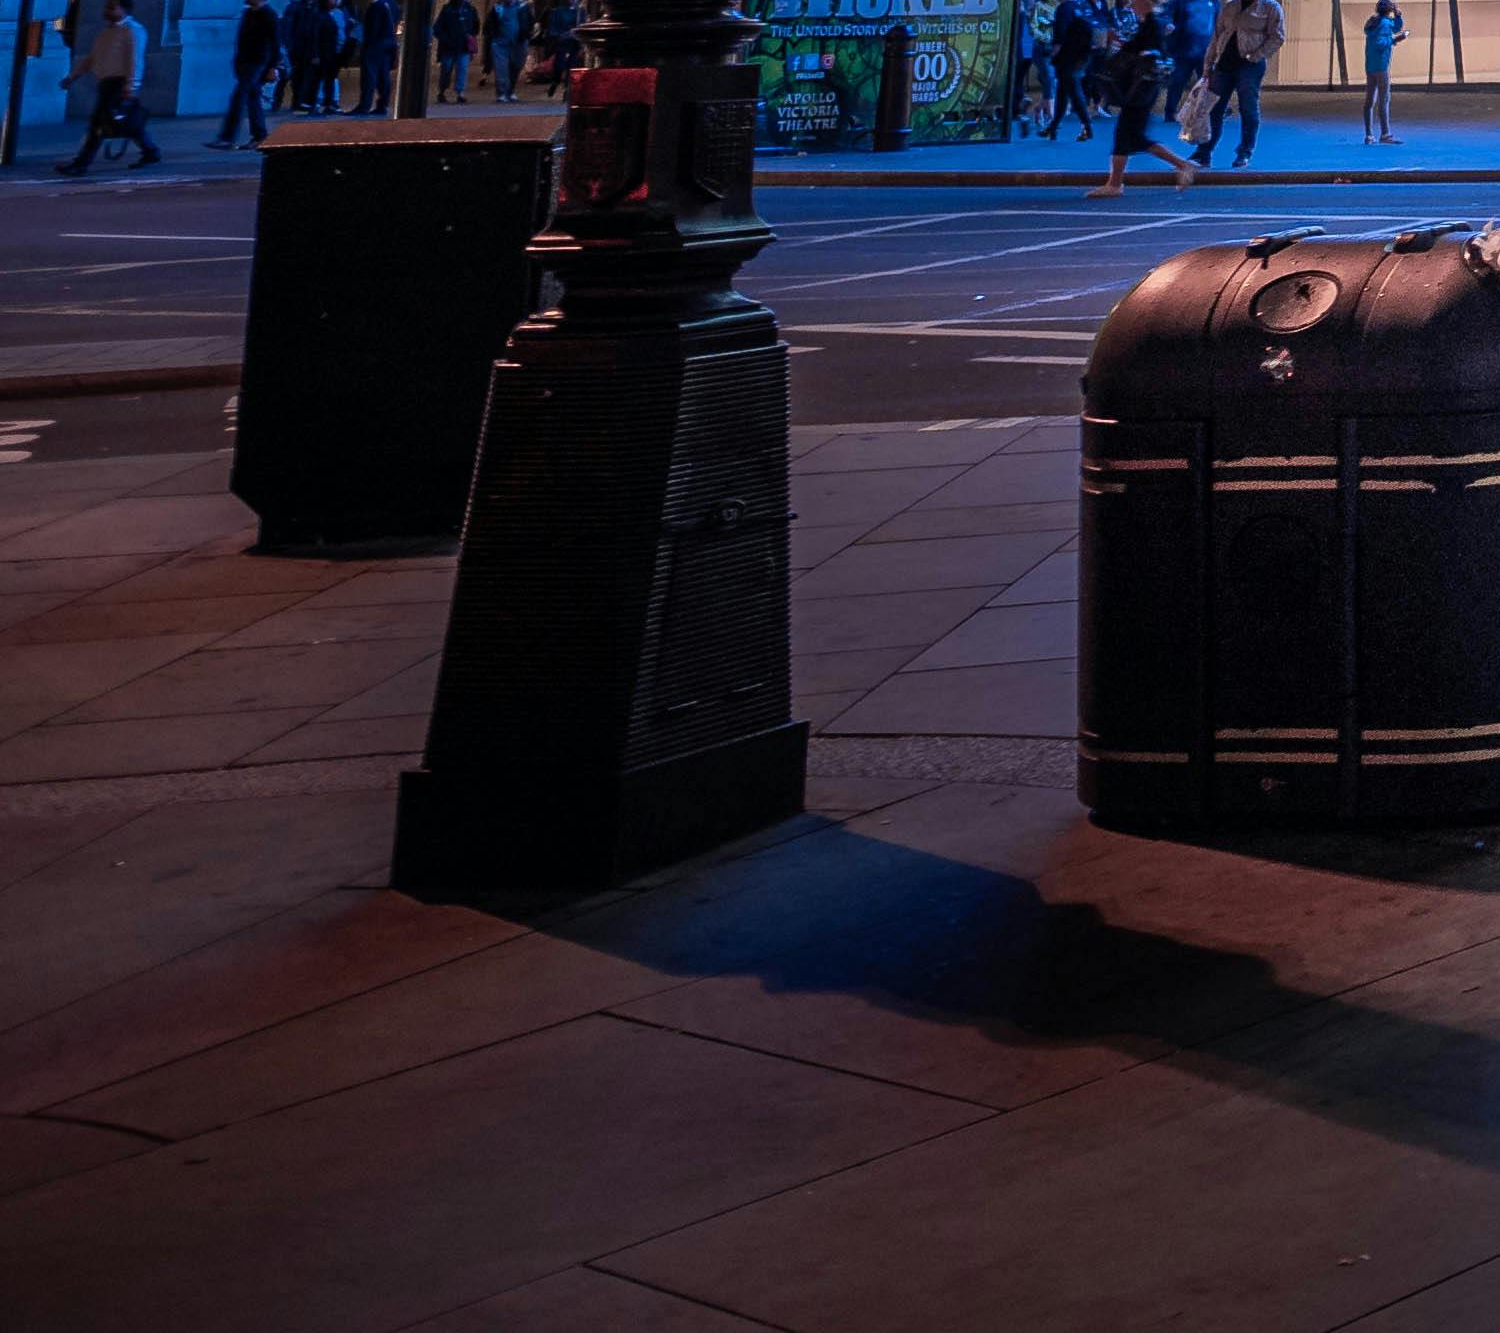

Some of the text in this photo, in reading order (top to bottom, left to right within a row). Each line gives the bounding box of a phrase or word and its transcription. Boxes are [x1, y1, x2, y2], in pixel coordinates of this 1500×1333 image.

[770, 25, 793, 38] THE
[795, 24, 841, 37] UNTOLD
[843, 23, 878, 37] STORY
[916, 22, 965, 36] WITCHES
[965, 22, 978, 35] OF
[914, 41, 947, 53] INNER!
[913, 53, 948, 82] 00
[784, 90, 836, 104] APOLLO
[911, 91, 940, 103] WARDS
[776, 104, 841, 119] VICTORIA
[776, 118, 838, 133] THEATRE
